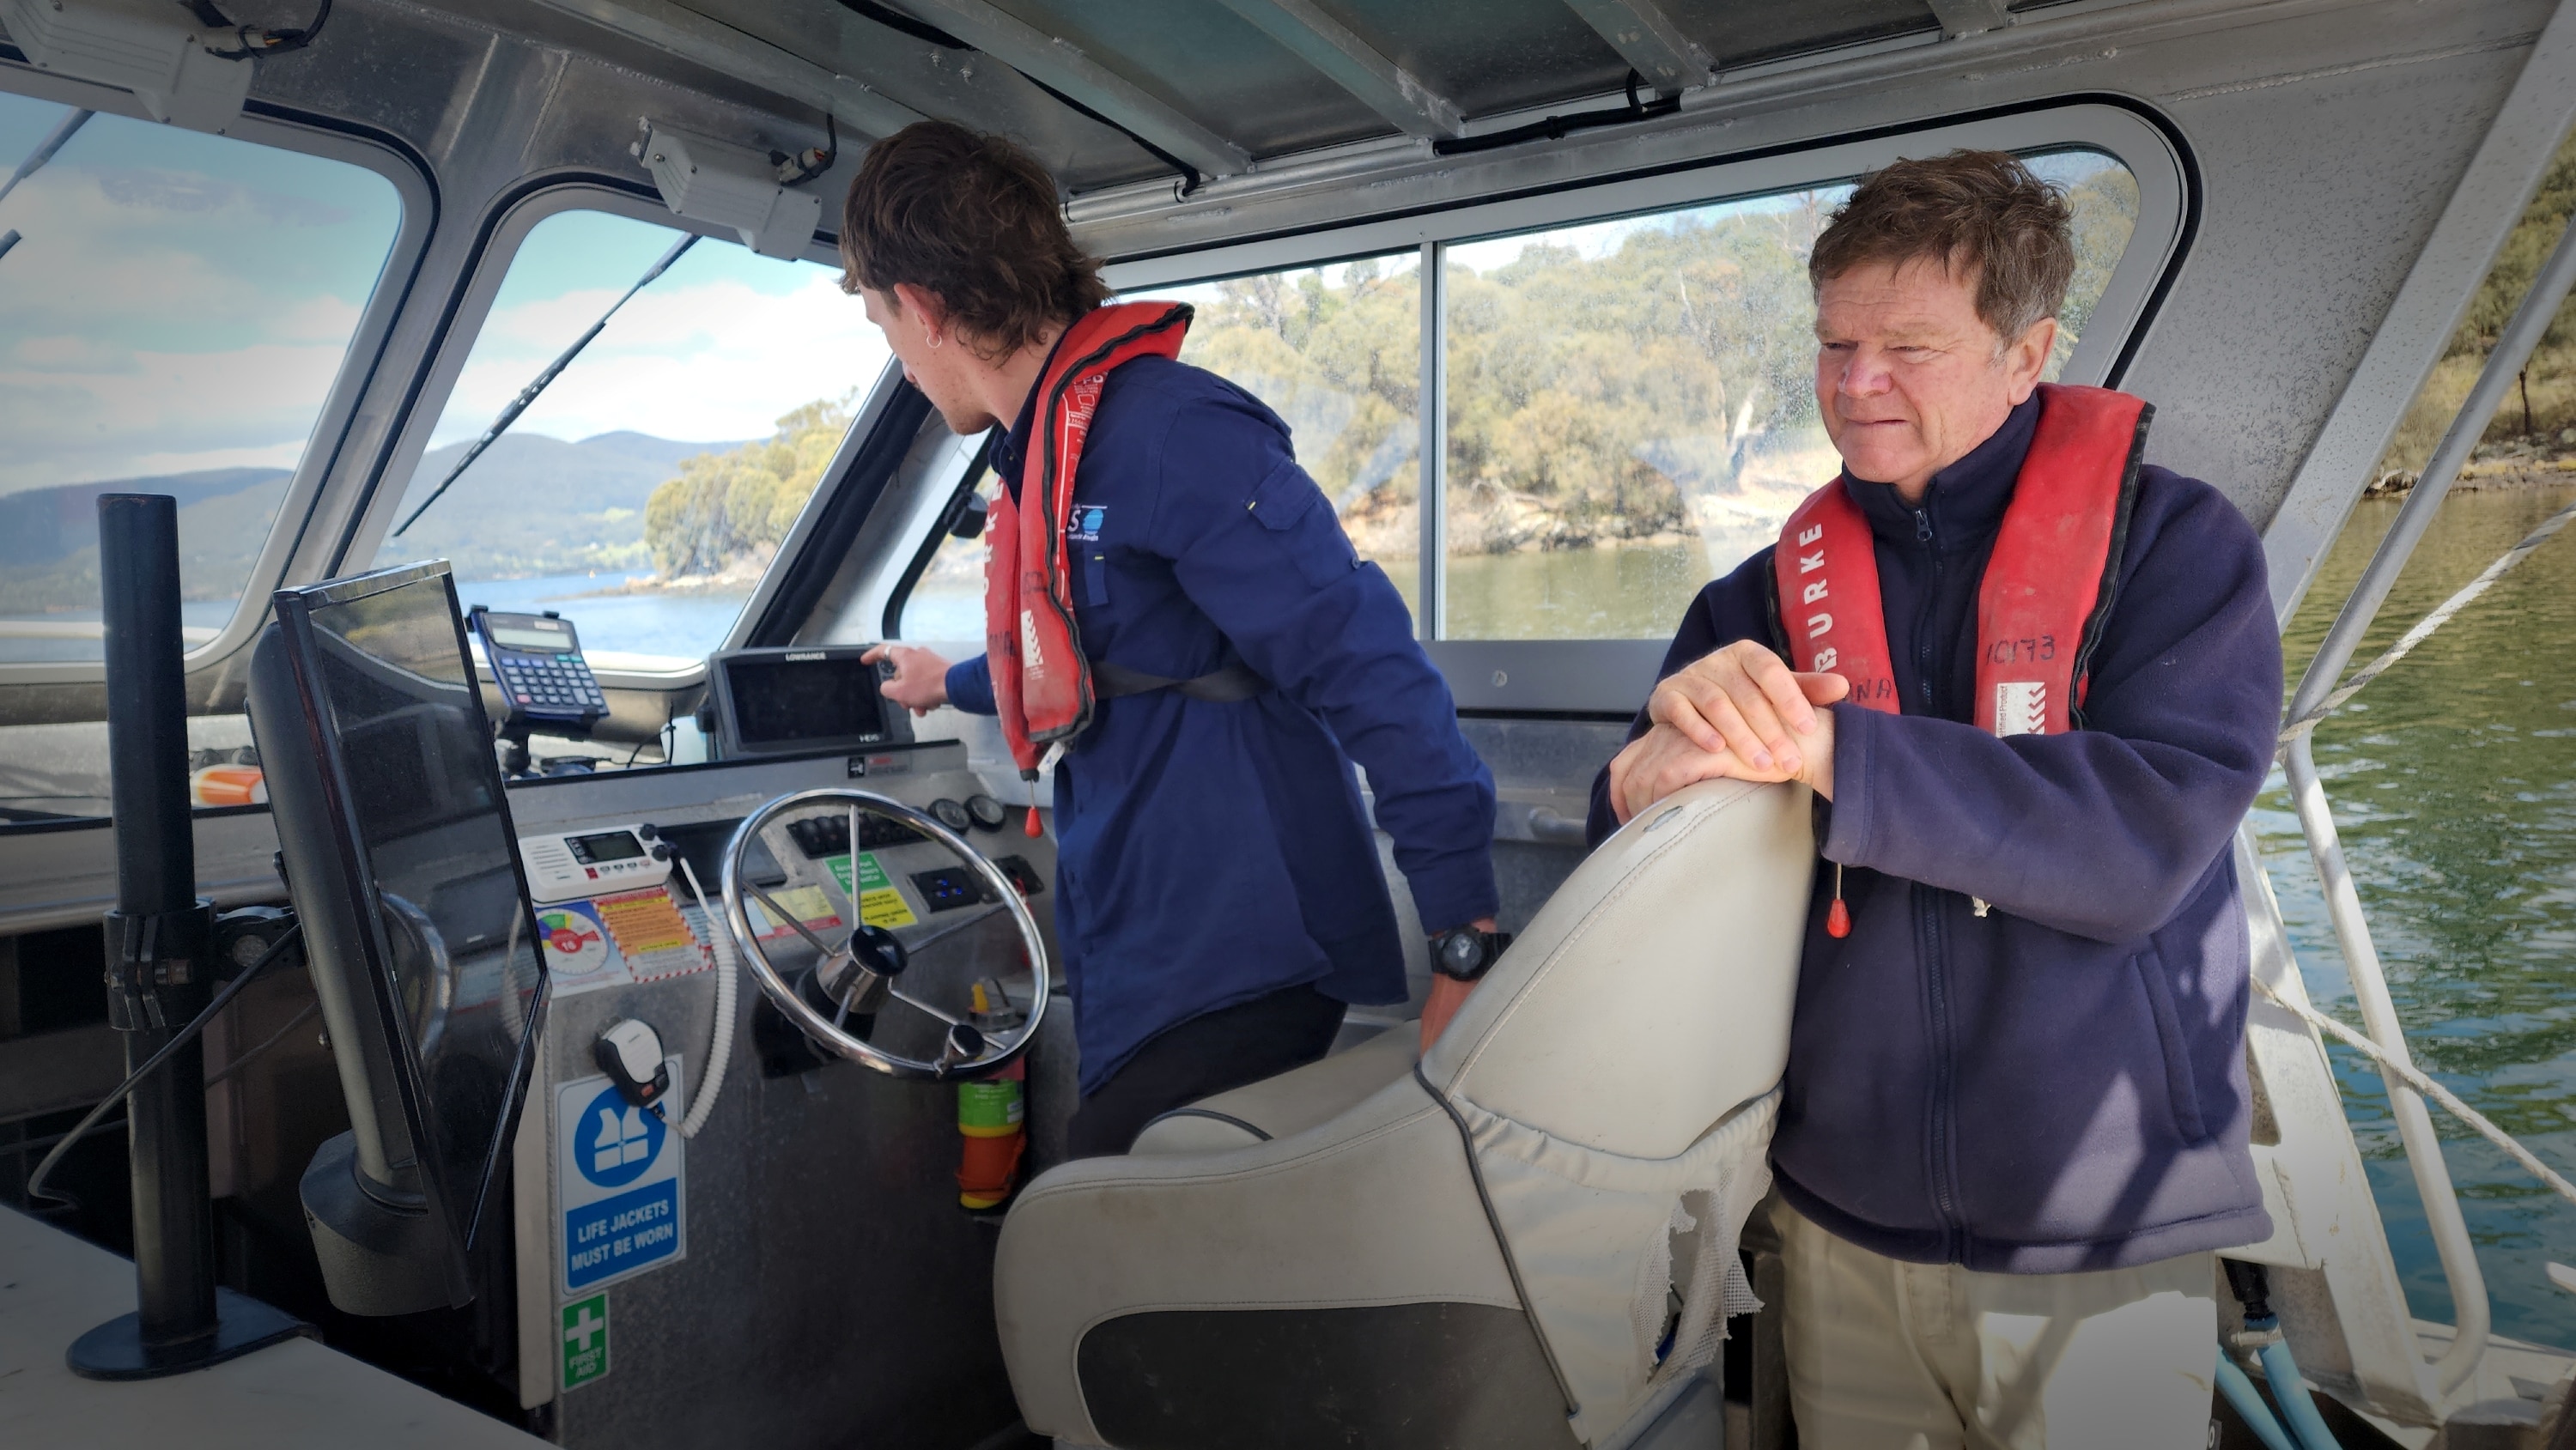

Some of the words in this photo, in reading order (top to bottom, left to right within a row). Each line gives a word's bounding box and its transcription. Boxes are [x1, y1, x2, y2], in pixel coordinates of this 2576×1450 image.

[1799, 523, 1838, 675] BURKE
[785, 652, 827, 662] LOWRANCE
[1986, 635, 2056, 665] 10173
[1999, 686, 2008, 712] Product
[578, 1219, 608, 1243] LIFE
[611, 1199, 669, 1233] JACKETS
[571, 1243, 611, 1271] MUST
[613, 1236, 632, 1257] BE
[634, 1222, 673, 1249] WORN
[568, 1347, 603, 1370] FIRST
[575, 1362, 597, 1378] AID
